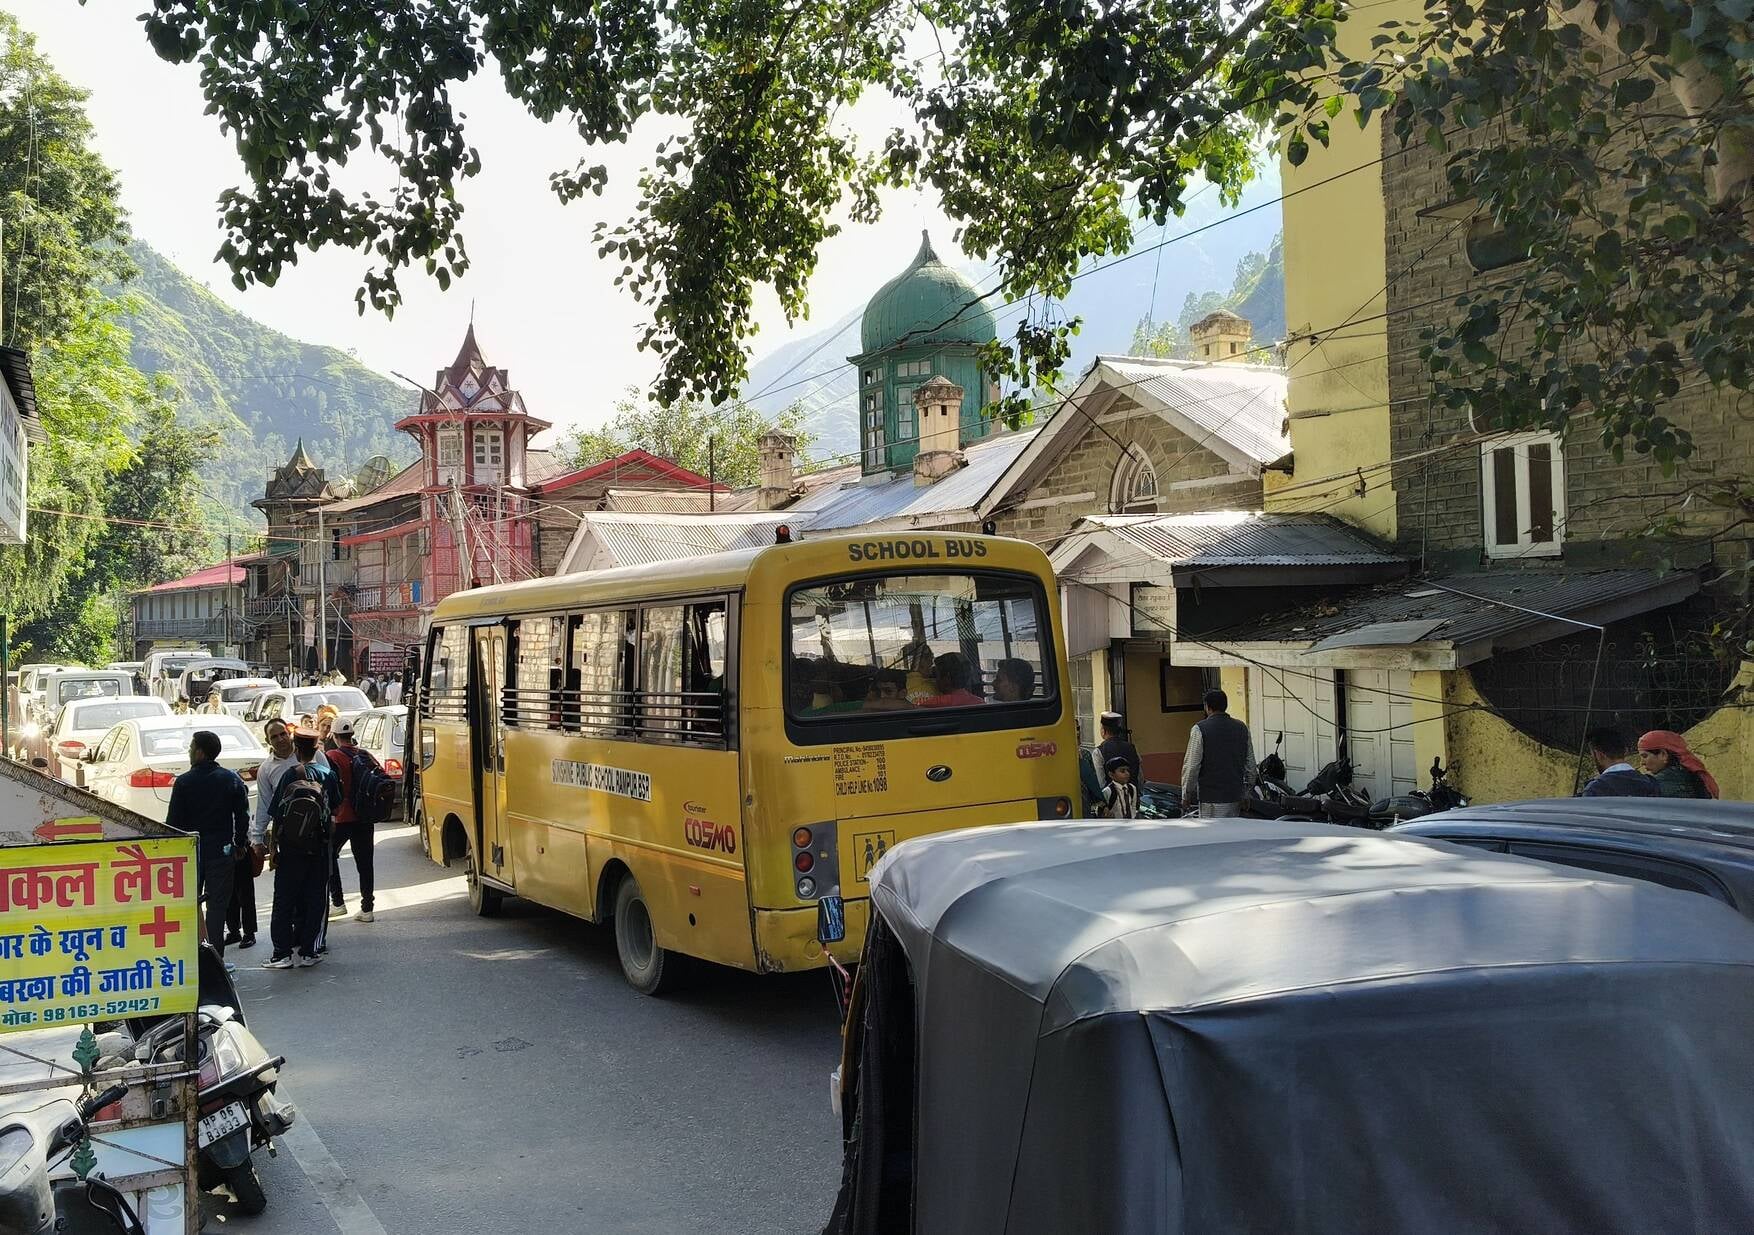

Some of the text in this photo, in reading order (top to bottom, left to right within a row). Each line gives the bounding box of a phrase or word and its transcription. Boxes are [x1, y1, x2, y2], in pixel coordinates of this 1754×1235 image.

[848, 540, 987, 561] SCHOOL BUS
[1016, 742, 1058, 759] COSMO
[552, 759, 650, 800] SUNSHINE PUBLIC SCHOOL RAMPUR BSR
[835, 766, 861, 774] AMBULANCE
[835, 782, 847, 796] CHILD
[847, 780, 858, 795] HELP
[858, 779, 868, 794] LINE
[873, 777, 888, 793] 1098
[684, 818, 736, 854] COSMO
[111, 844, 188, 903] लैब
[29, 925, 53, 956] के
[58, 928, 104, 962] खून
[110, 925, 127, 949] व
[60, 966, 92, 997] की
[98, 960, 154, 993] जाती
[43, 998, 160, 1022] 98163-52427
[203, 1106, 234, 1129] HP 06
